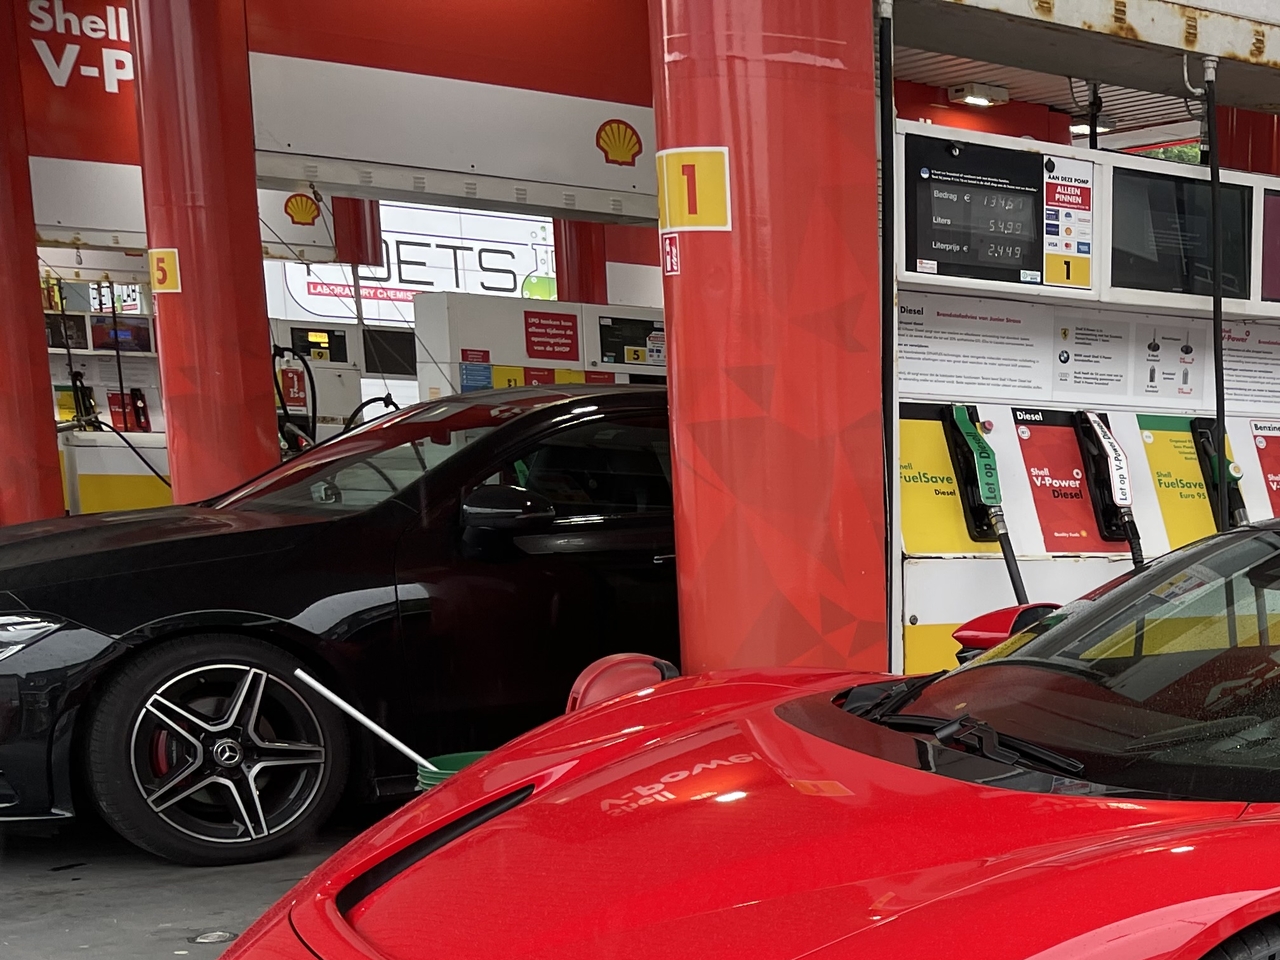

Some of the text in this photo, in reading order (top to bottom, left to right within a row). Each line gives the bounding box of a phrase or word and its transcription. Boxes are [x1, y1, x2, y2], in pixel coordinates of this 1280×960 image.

[29, 0, 130, 42] Shell
[682, 164, 698, 215] 1
[1056, 186, 1080, 195] ALLEEN
[934, 190, 958, 202] Bedrag
[964, 194, 971, 203] €
[1055, 194, 1082, 203] PINNEN
[933, 216, 951, 225] Liters
[932, 241, 960, 252] Literprijs
[156, 258, 167, 284] 5
[1064, 260, 1070, 280] 1
[900, 306, 923, 315] Diesel
[633, 350, 640, 360] 5
[1017, 412, 1043, 421] Diesel
[1108, 440, 1124, 471] V-Power
[984, 464, 996, 478] op
[1030, 468, 1049, 476] Shell
[900, 472, 953, 484] uelSave
[1032, 477, 1081, 488] V-Power
[1119, 474, 1127, 485] op
[1157, 478, 1204, 490] FuelSave
[986, 485, 996, 500] Let
[1052, 490, 1083, 499] Diesel
